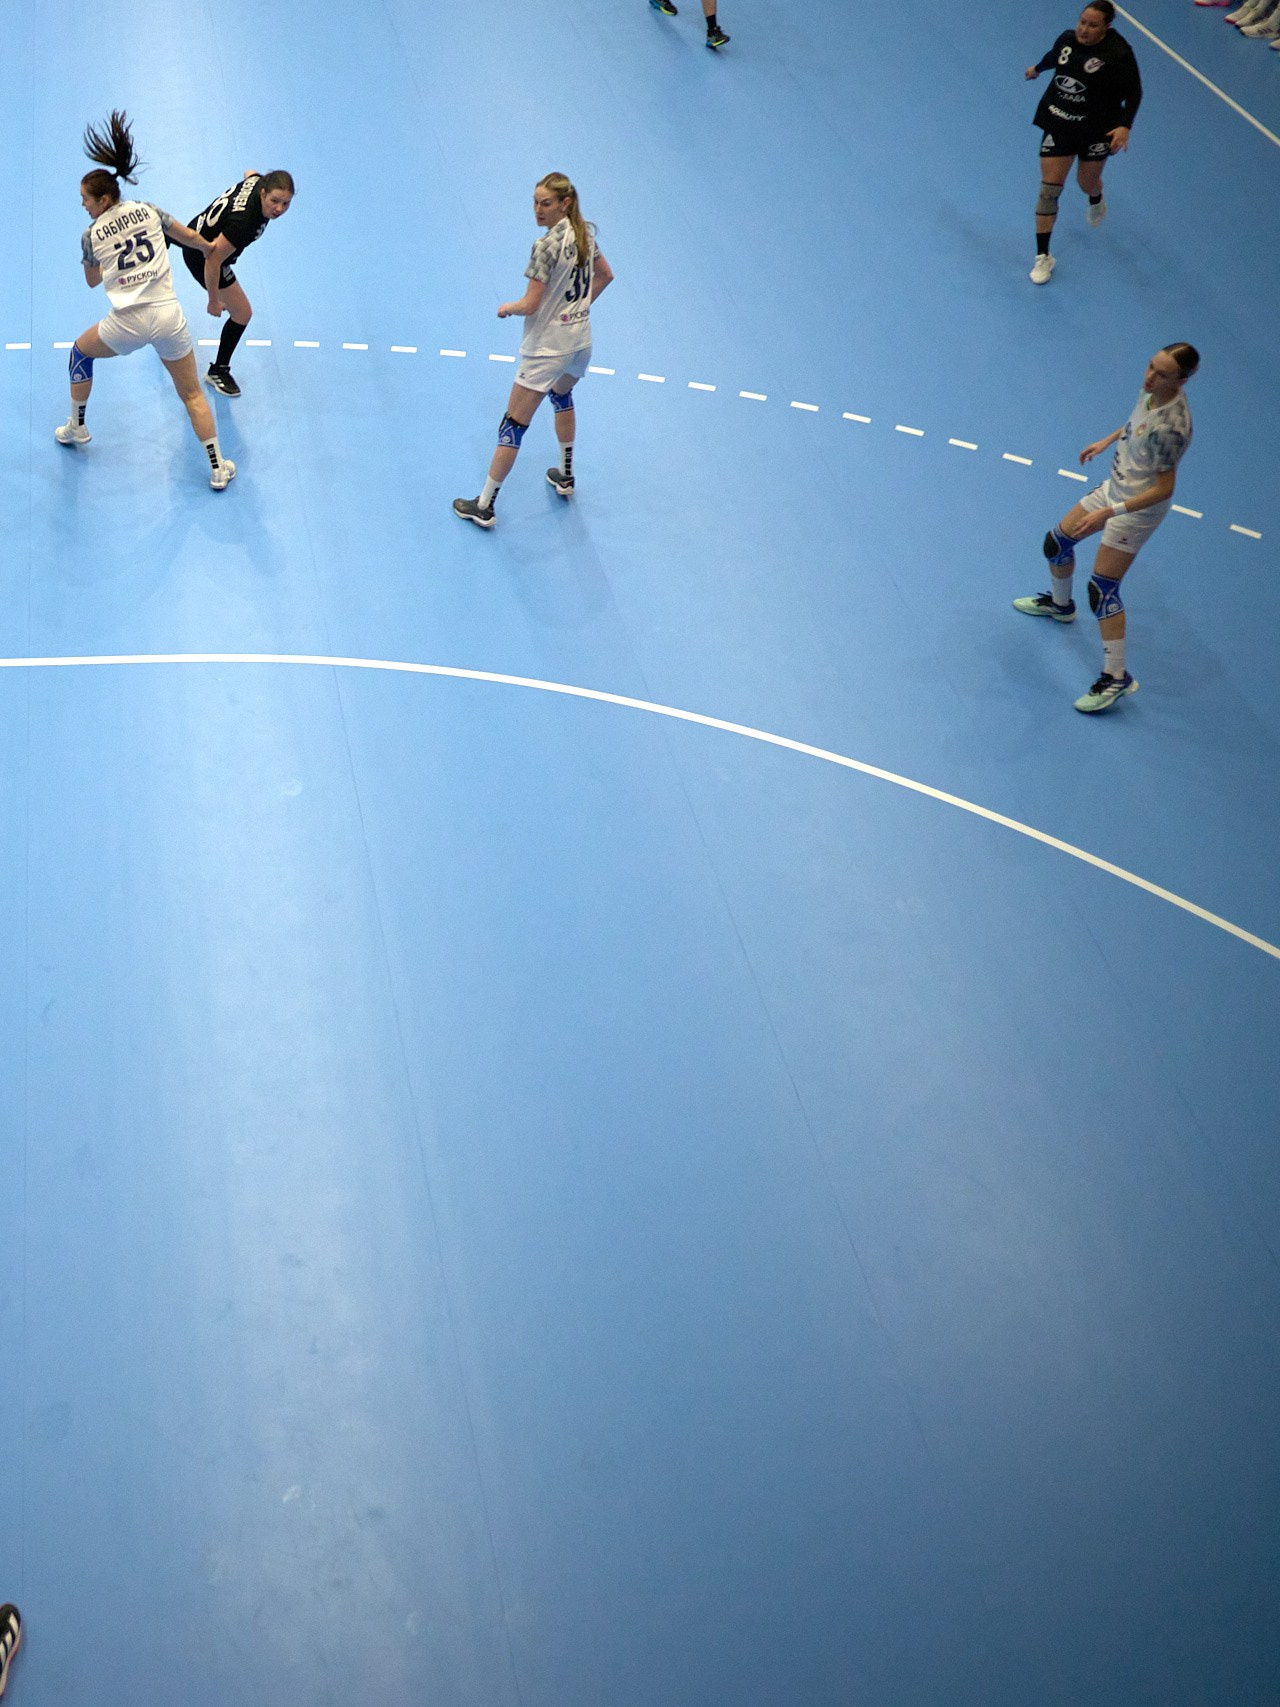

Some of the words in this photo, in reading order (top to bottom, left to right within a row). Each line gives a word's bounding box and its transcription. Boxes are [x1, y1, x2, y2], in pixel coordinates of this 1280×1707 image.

[1058, 46, 1072, 65] 8
[96, 207, 151, 241] САБИРОВА
[114, 230, 155, 271] 25
[126, 270, 158, 283] РУСКОН
